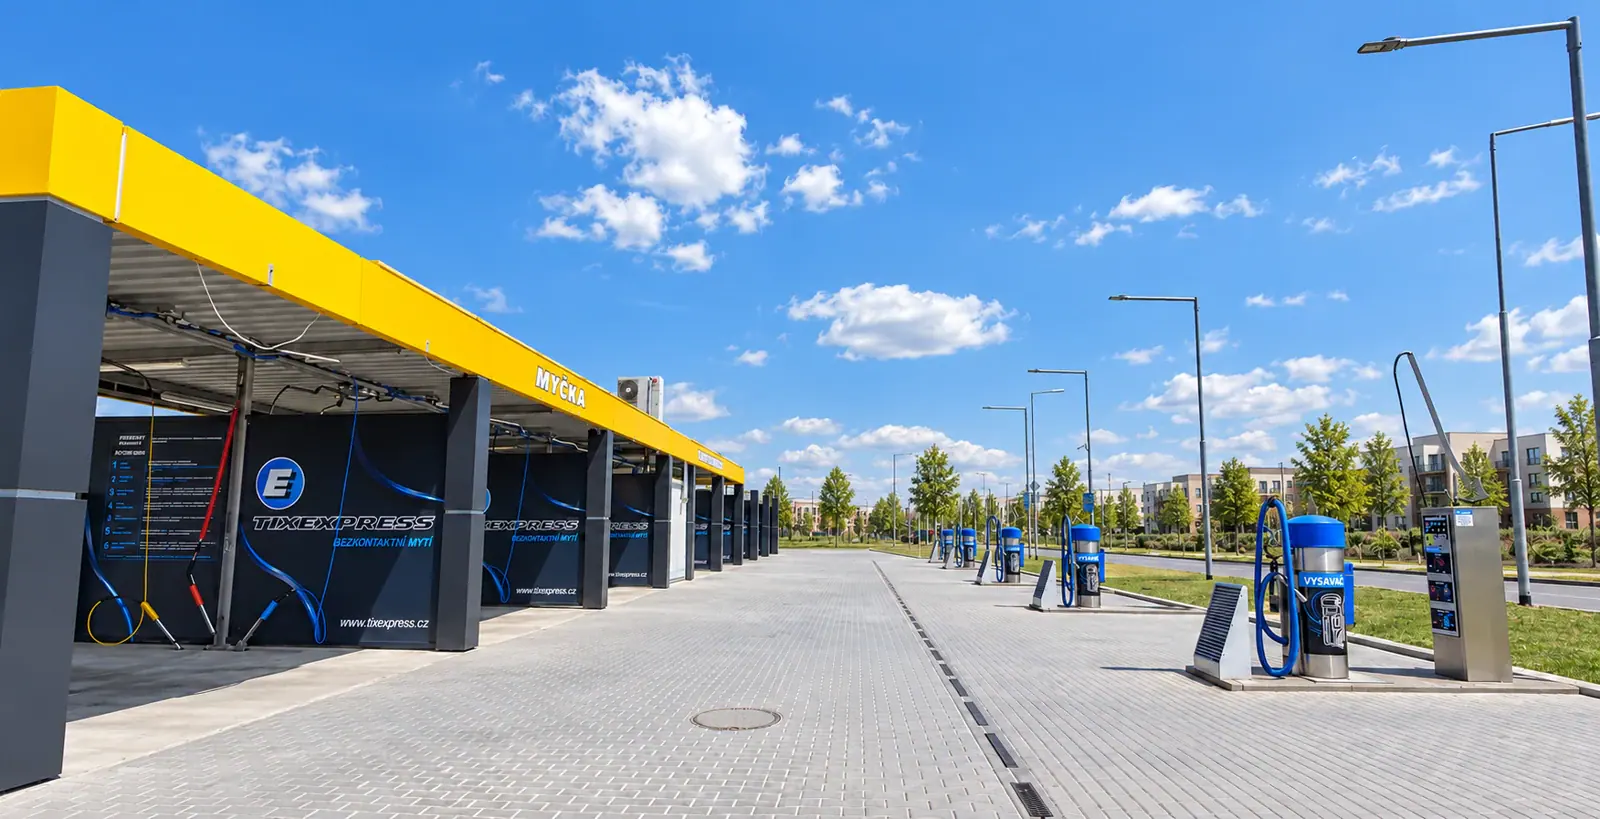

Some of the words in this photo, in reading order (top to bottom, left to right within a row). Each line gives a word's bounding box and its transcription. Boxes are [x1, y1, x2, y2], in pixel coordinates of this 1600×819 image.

[536, 366, 586, 409] MYČKA
[262, 468, 295, 498] E
[252, 515, 436, 531] TIXEXPRESS
[103, 541, 109, 550] 6
[333, 535, 407, 548] BEZKONTAKTNÍ
[407, 535, 434, 548] MYTÍ
[340, 617, 430, 631] www.tixexpress.cz
